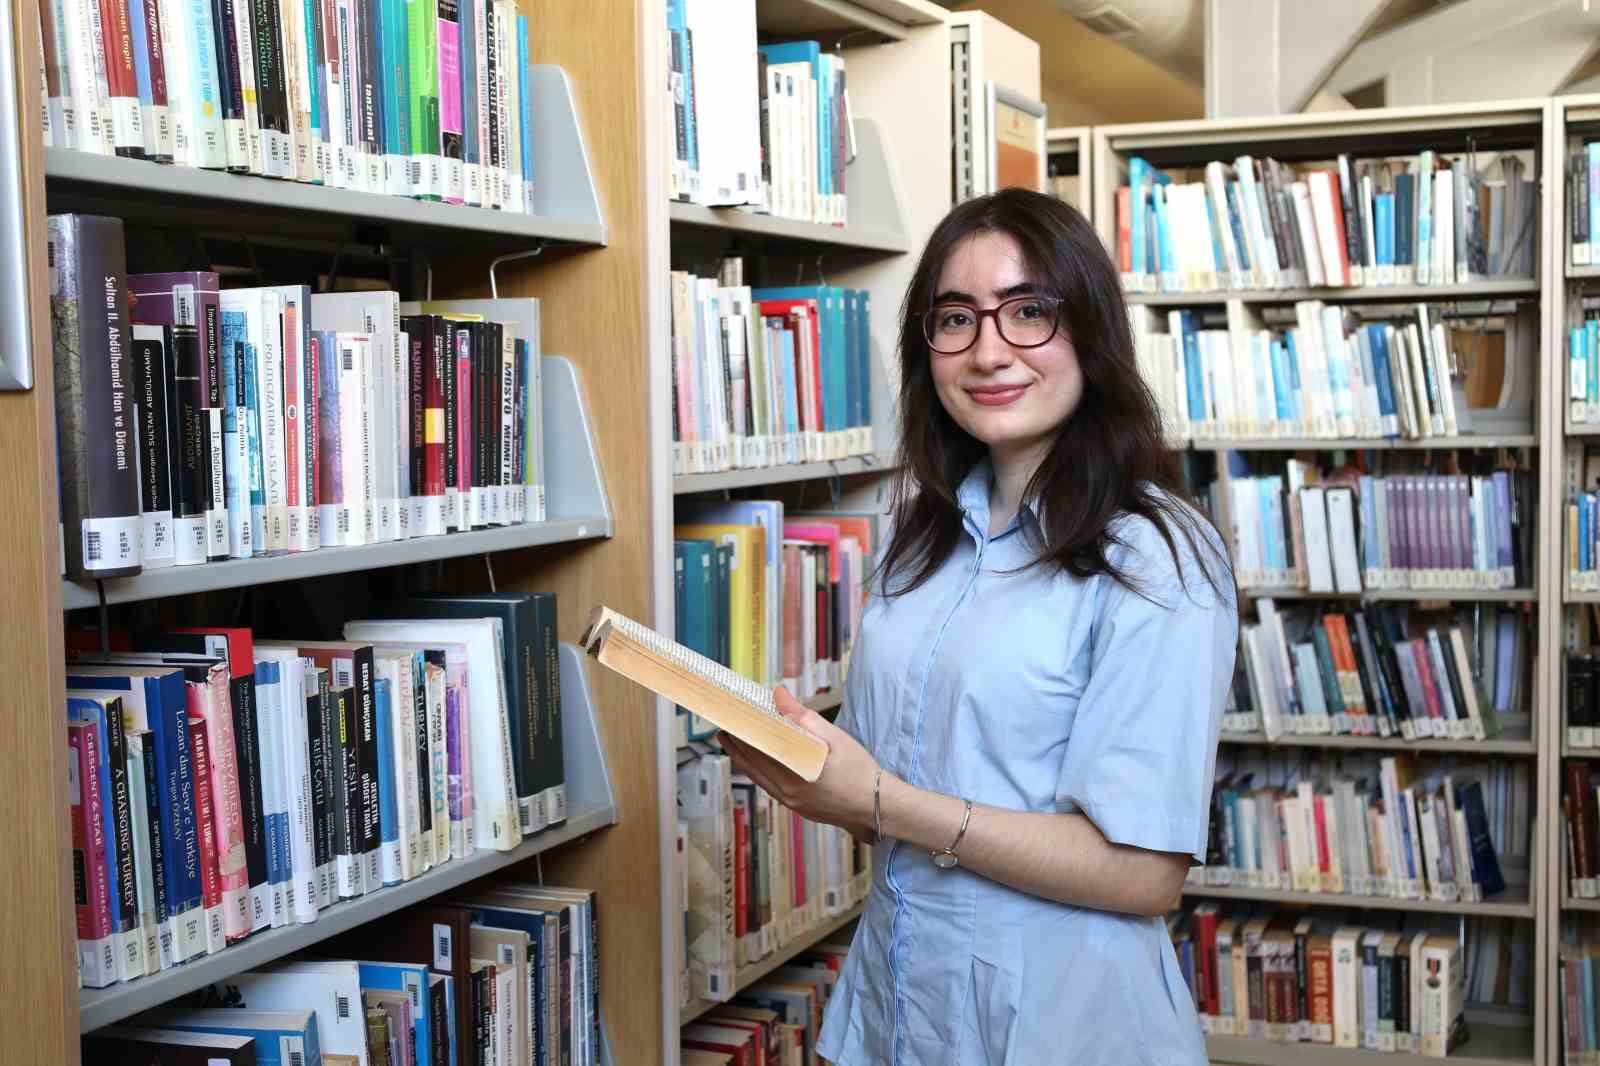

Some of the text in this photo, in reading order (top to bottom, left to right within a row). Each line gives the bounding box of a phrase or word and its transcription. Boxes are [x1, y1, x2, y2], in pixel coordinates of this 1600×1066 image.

[118, 0, 132, 70] toman Empire
[147, 7, 160, 58] Difference
[258, 31, 268, 88] THOUGHT
[264, 25, 272, 68] YOUNG
[365, 83, 374, 140] tanzimat
[207, 308, 216, 363] İmparatorluğun
[104, 275, 127, 469] Sultan II. Abdülhamid Han ve Dönemi
[143, 348, 153, 408] ABDÜLHAMİD
[264, 343, 275, 435] POLITICIZATION
[147, 412, 155, 446] SULTAN
[503, 424, 511, 468] MEHMET
[212, 446, 221, 502] Abdülhamid
[503, 472, 511, 484] BA
[361, 694, 371, 741] GÜNÇIKAN
[416, 691, 426, 751] TURKEY
[86, 733, 97, 797] CRESCENT
[92, 811, 101, 845] STAR
[175, 710, 196, 879] Lozan'dan Sevr'e Türkiye
[361, 773, 372, 838] ŞİDDET TARİHİ
[370, 782, 378, 823] DEVLETİN
[115, 768, 134, 904] A CHANGING TURKEY
[153, 820, 161, 857] OYUNLARI
[97, 865, 106, 912] STEPHEN
